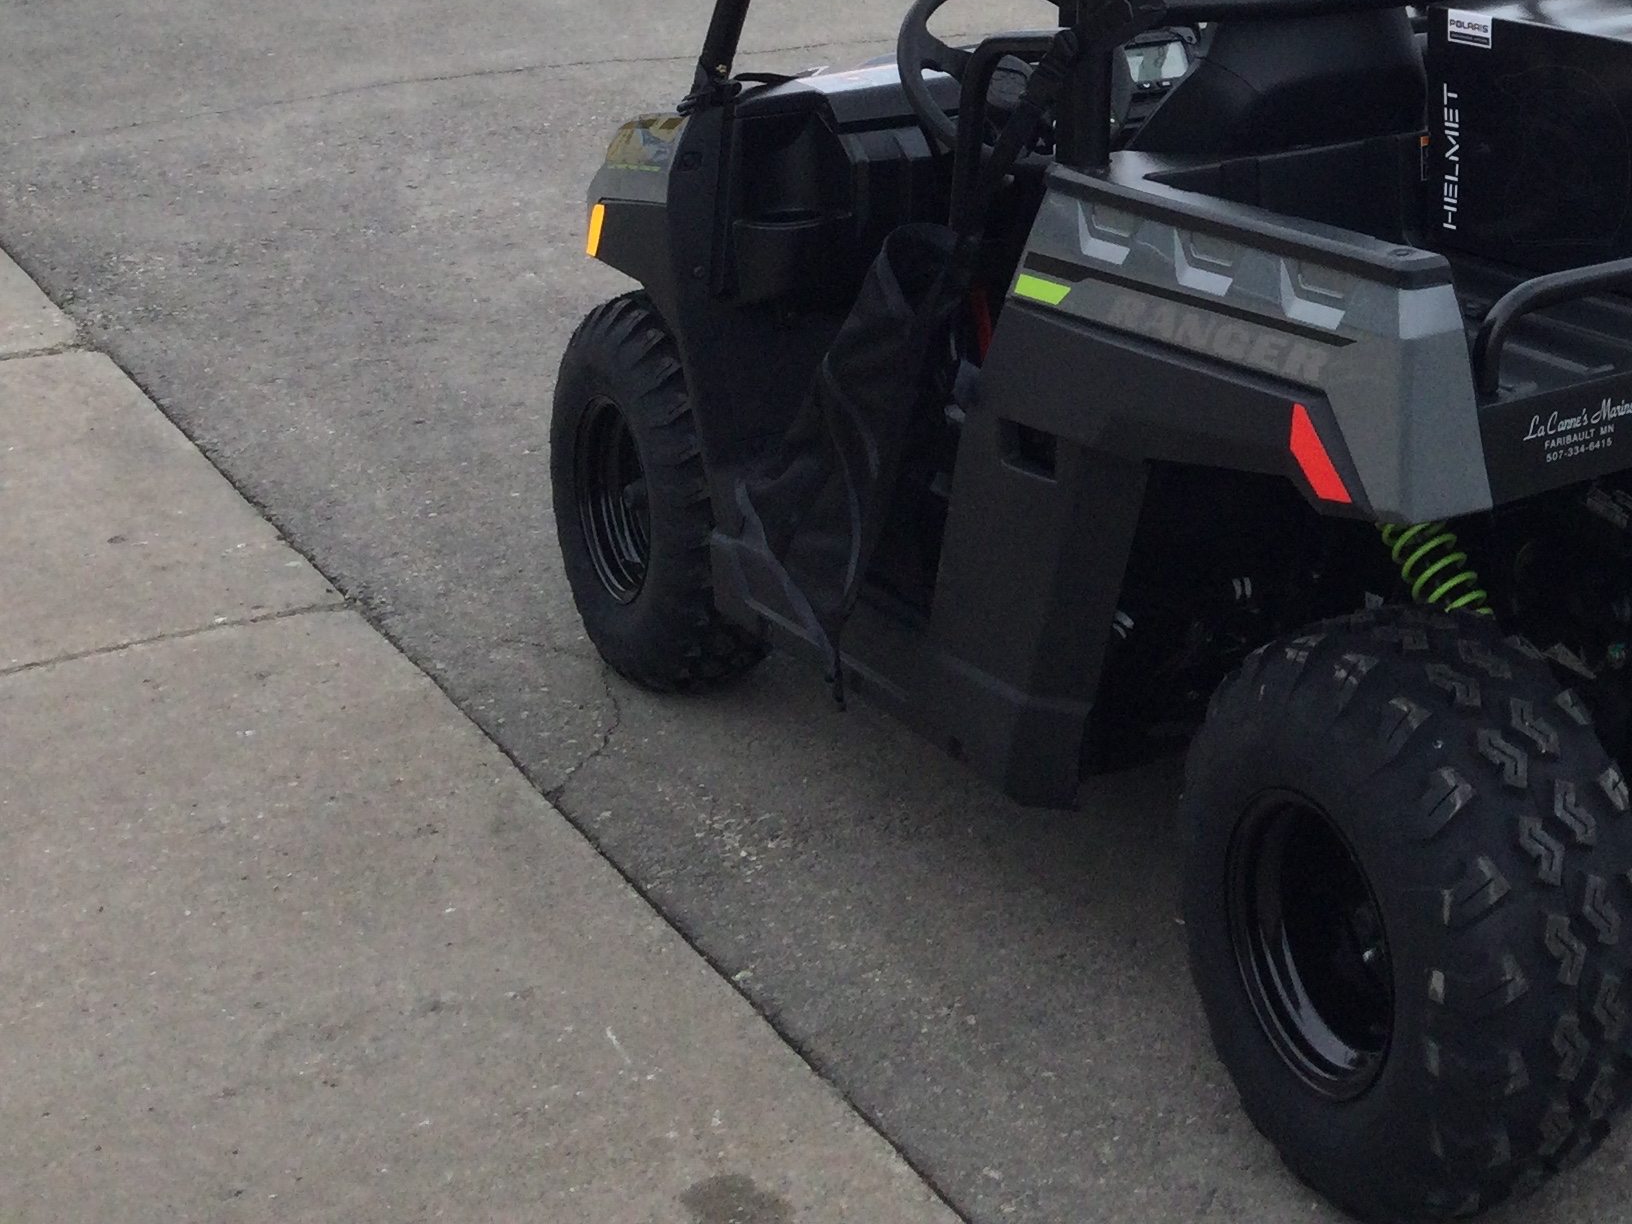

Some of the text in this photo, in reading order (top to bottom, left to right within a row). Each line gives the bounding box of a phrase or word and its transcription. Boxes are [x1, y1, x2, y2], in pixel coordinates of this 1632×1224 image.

[1449, 18, 1490, 34] POLARIS
[1443, 82, 1460, 231] HELMET
[1107, 296, 1329, 381] RANGER
[1544, 424, 1615, 450] FARIBAULT MN
